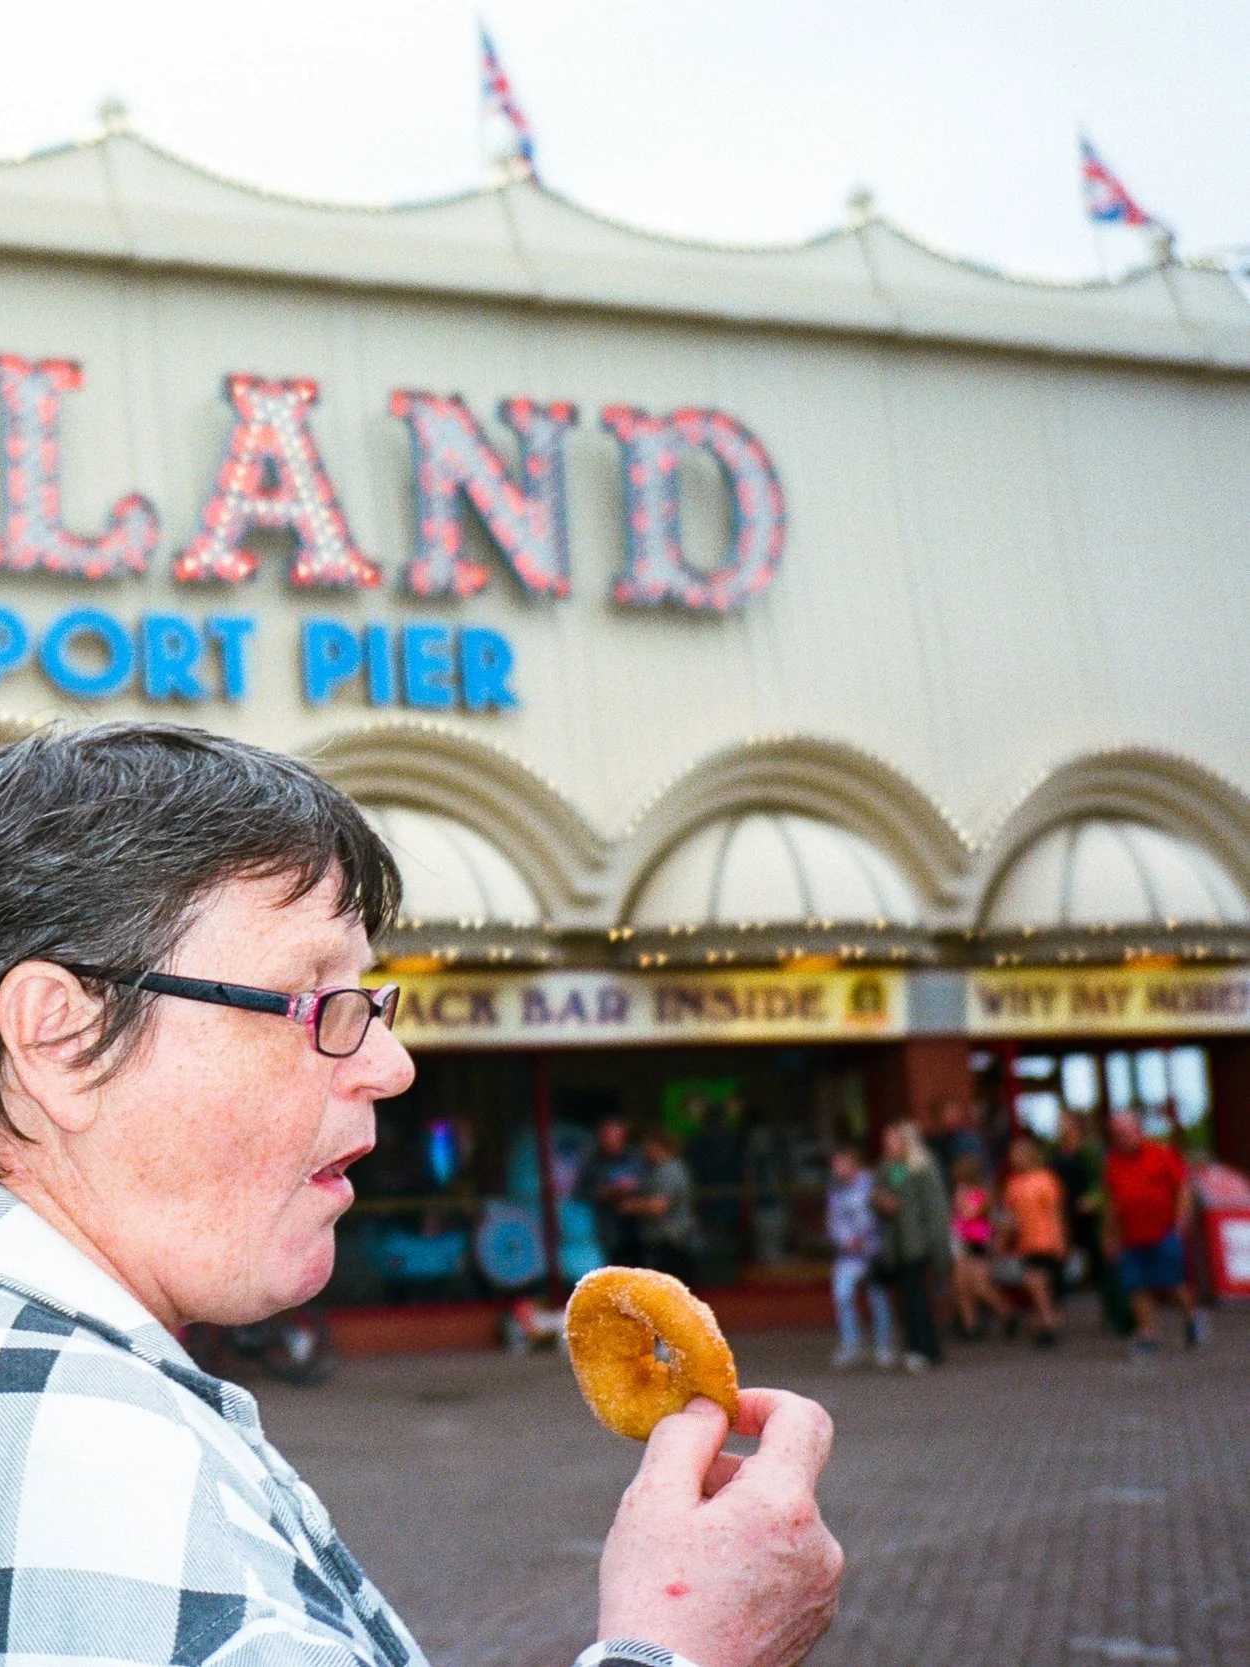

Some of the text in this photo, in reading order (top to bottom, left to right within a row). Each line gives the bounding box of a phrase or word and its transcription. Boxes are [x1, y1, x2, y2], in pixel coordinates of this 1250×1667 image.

[301, 617, 518, 712] PIER
[519, 986, 630, 1026] BAR
[656, 985, 828, 1023] INSIDE
